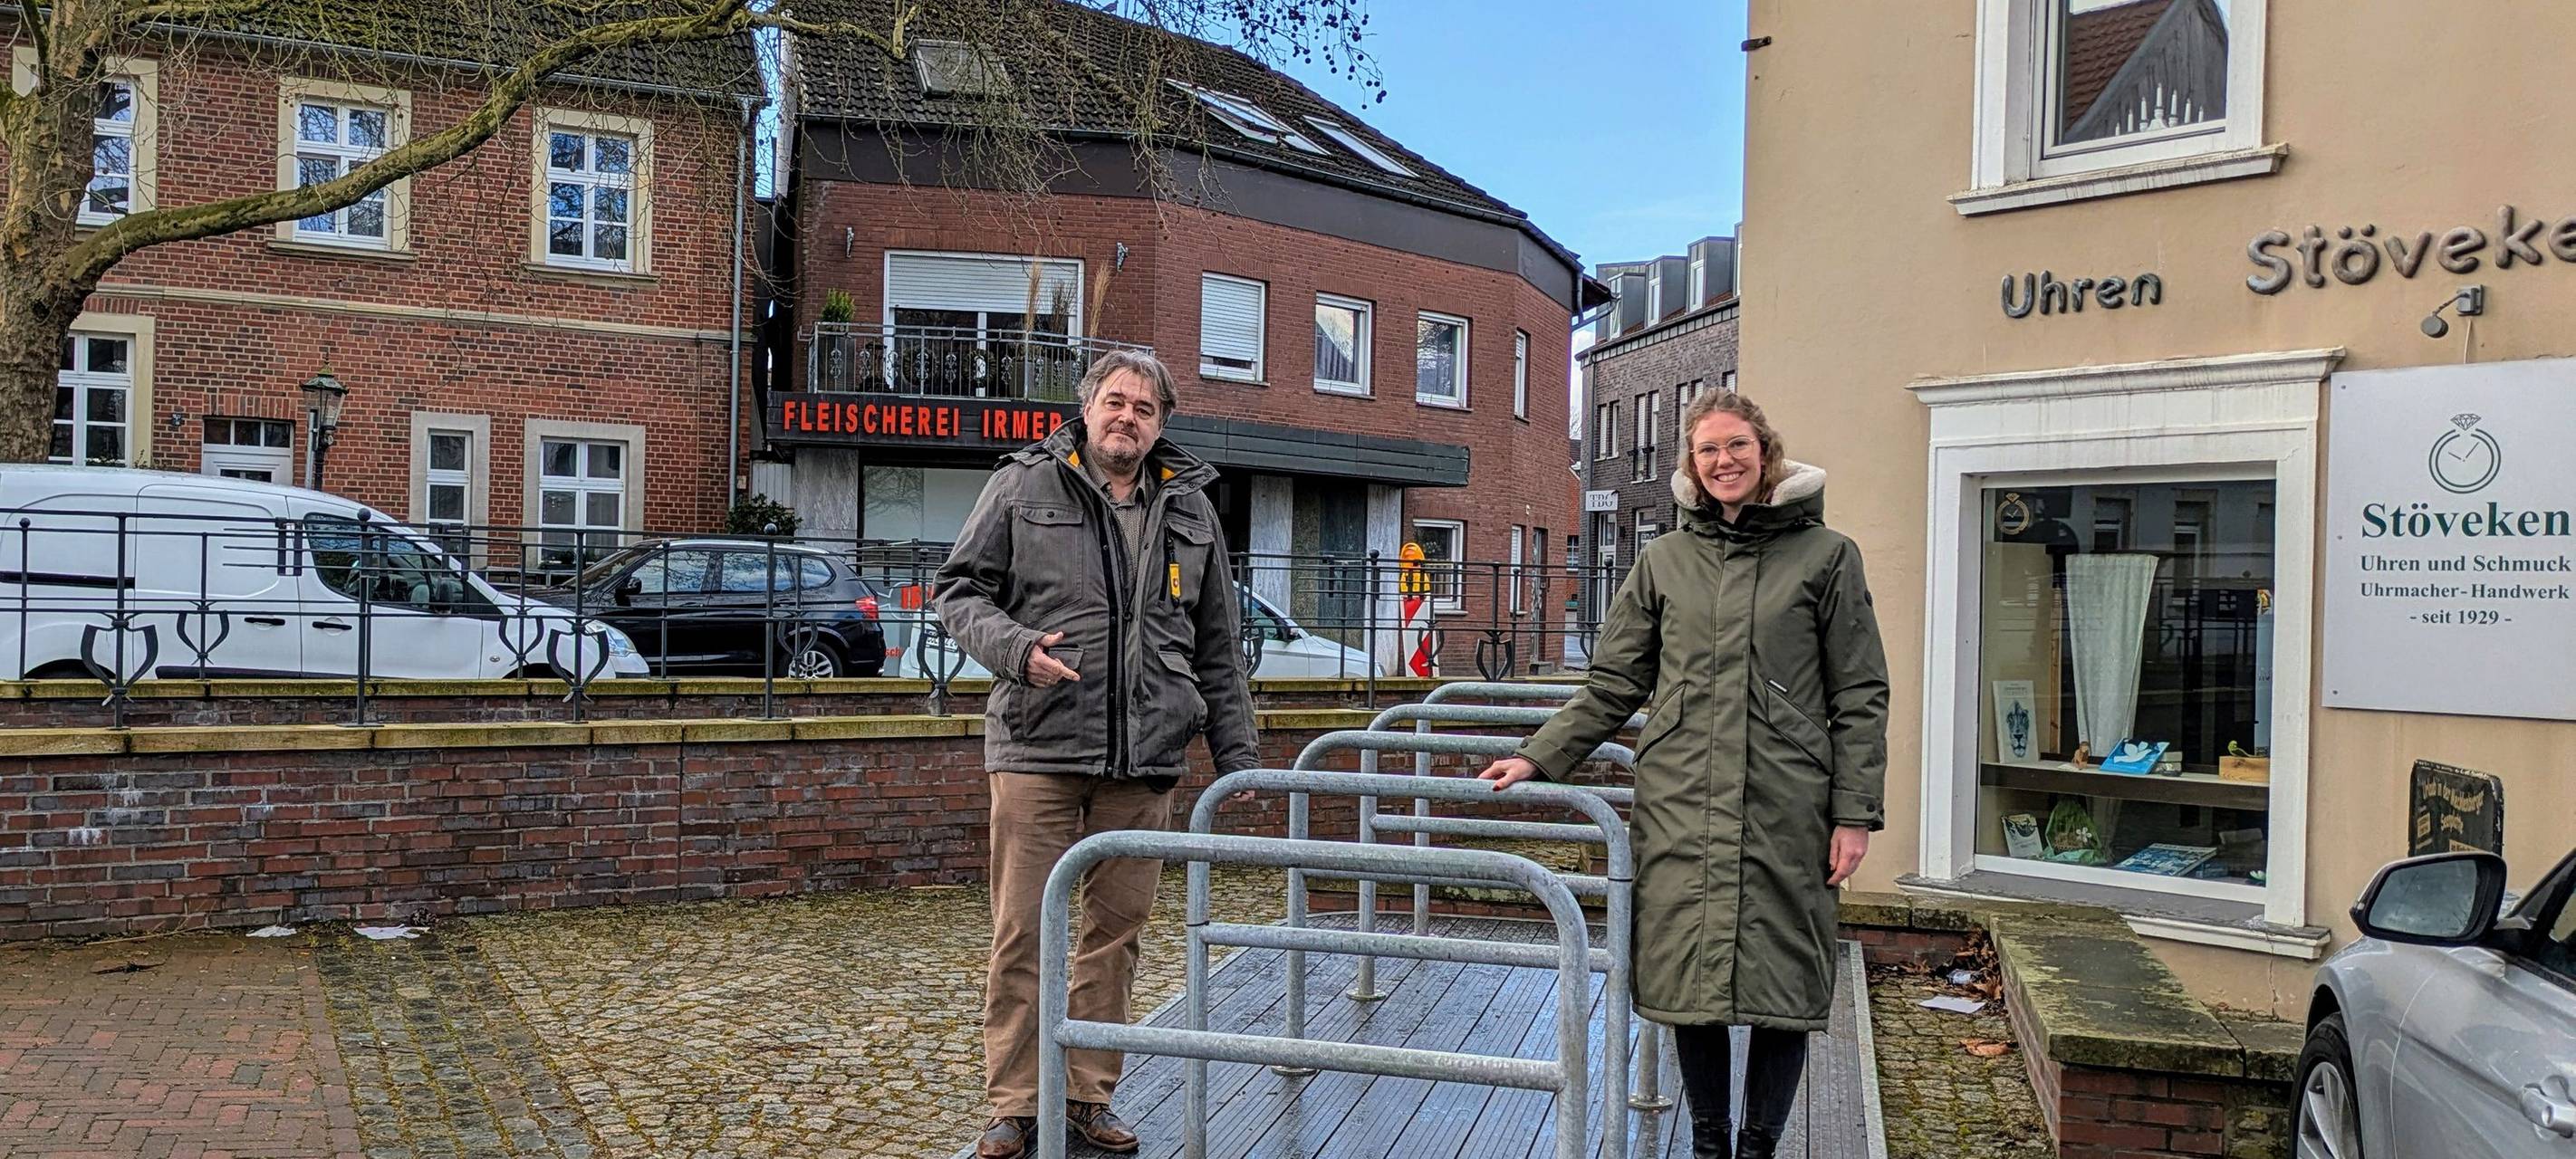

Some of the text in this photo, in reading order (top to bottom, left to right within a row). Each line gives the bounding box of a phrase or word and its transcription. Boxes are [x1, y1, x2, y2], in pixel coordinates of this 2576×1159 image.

[2001, 270, 2162, 318] Uhren
[783, 401, 960, 436] FLEISCHEREI
[2361, 502, 2571, 538] Stöveken
[2360, 554, 2571, 572] Uhren und Schmuck
[2360, 582, 2570, 599] Uhrmacher-Handwerk
[2422, 609, 2450, 624] seit
[2458, 609, 2499, 625] 1929
